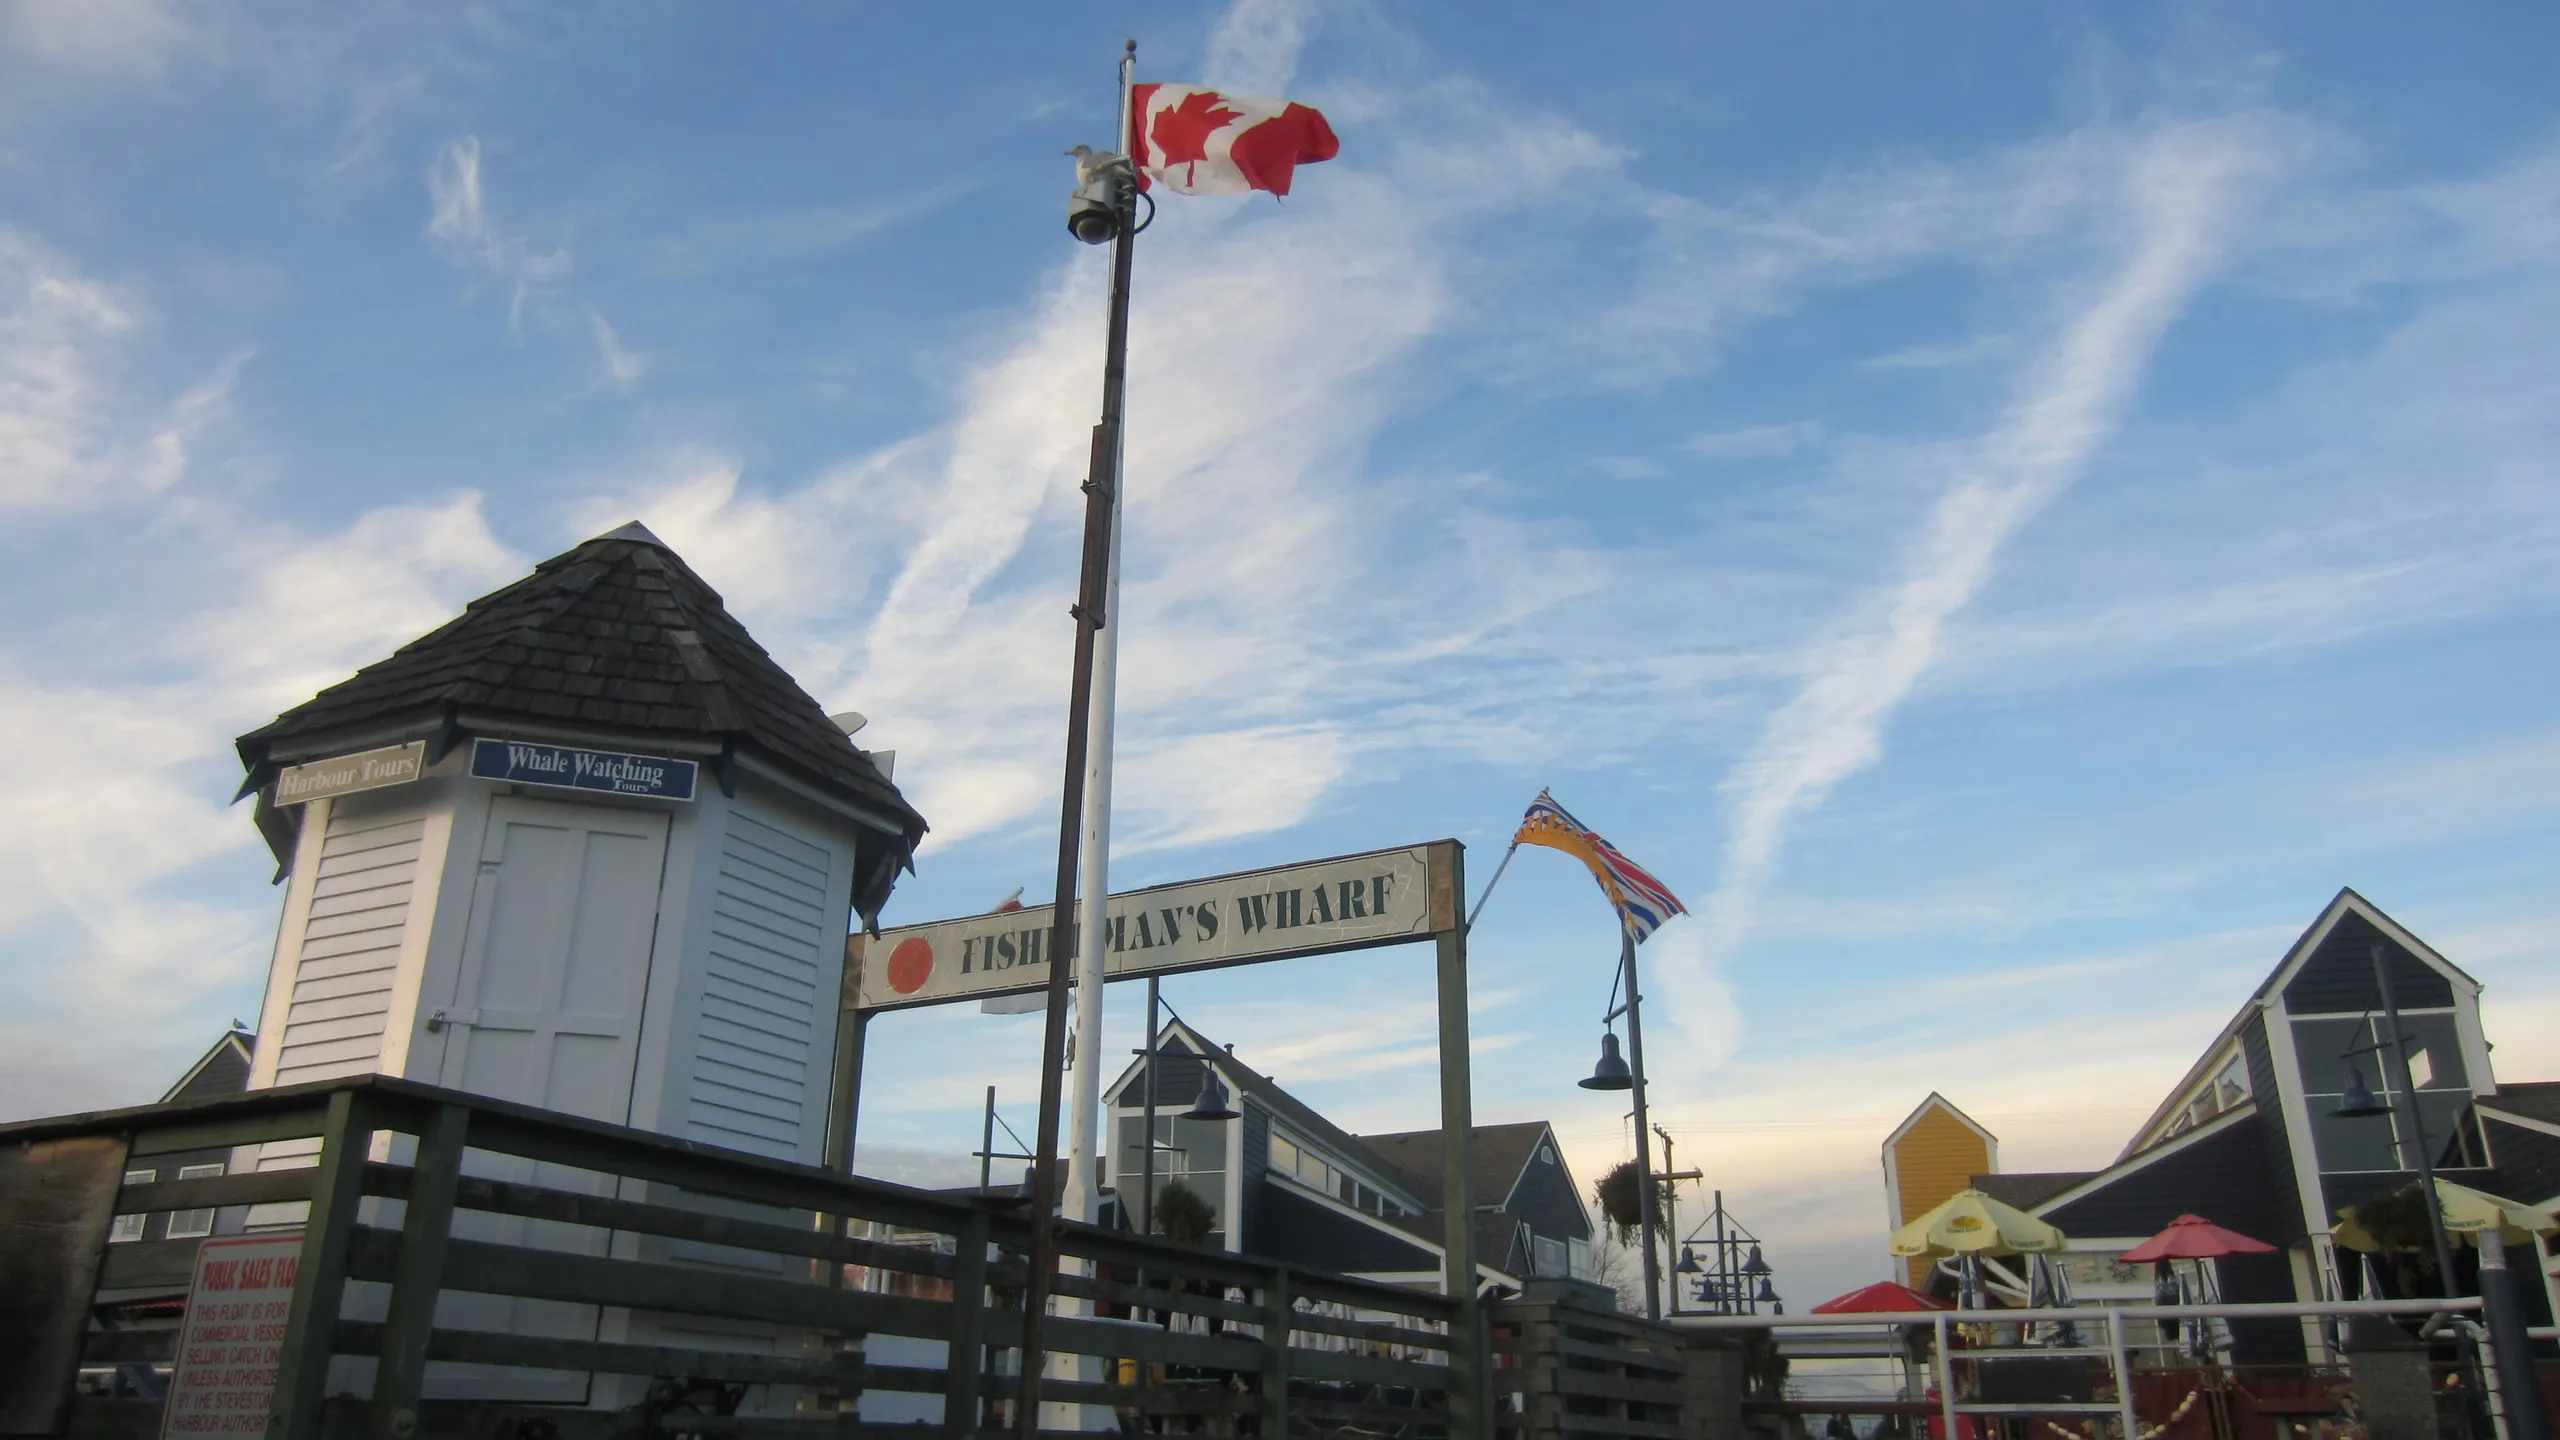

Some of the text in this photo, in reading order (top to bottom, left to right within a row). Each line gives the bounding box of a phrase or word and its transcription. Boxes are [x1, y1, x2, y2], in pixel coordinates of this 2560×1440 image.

[507, 743, 664, 788] Whale Watching
[282, 757, 415, 796] Harbour Tours
[613, 779, 648, 793] Tours
[960, 871, 1396, 975] FISHMAN'S WHARF
[240, 1258, 274, 1290] SALES
[274, 1256, 299, 1288] FLO
[196, 1301, 287, 1321] THIS FLOAT IS FOR
[191, 1323, 288, 1343] COMMERCIAL VESSE
[186, 1348, 227, 1365] SELLING
[229, 1347, 261, 1364] CATCH
[182, 1369, 219, 1387] UNLESS
[177, 1392, 191, 1409] BY
[194, 1392, 213, 1409] THE
[172, 1414, 219, 1432] HARBOUR
